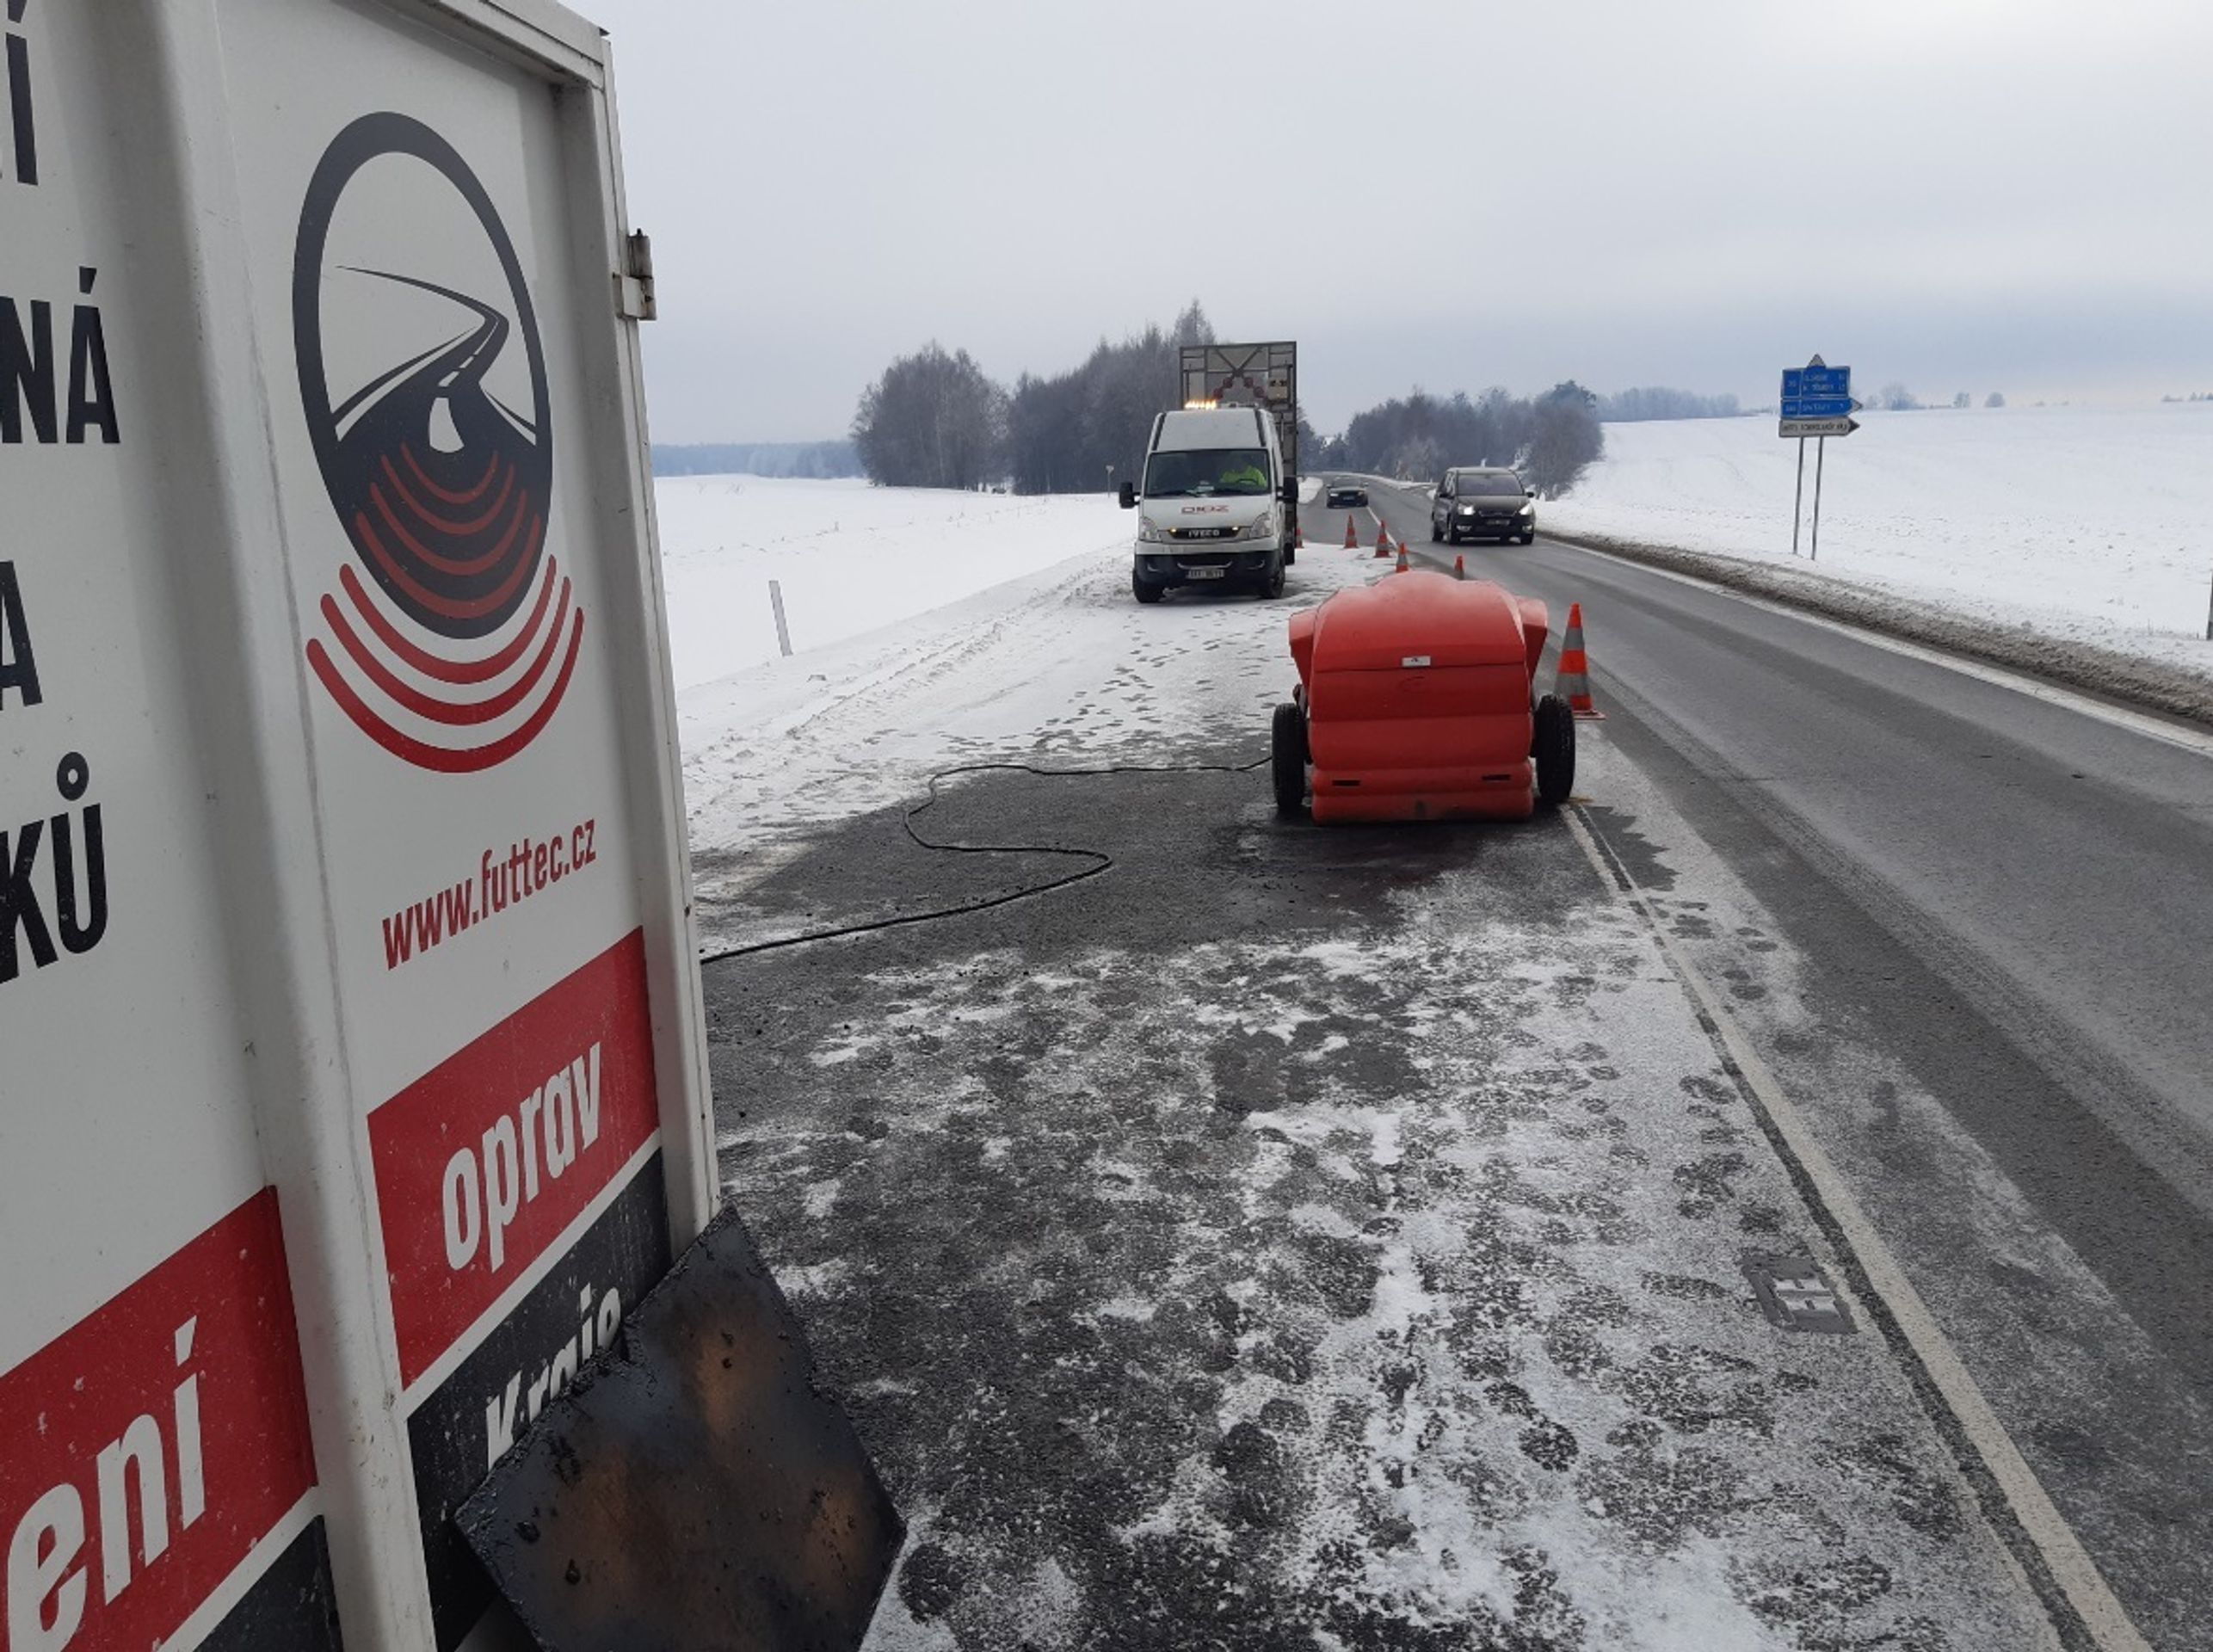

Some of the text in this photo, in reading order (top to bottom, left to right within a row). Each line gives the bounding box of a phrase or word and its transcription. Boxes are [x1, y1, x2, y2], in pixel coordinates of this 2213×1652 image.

[0, 266, 120, 443] NÁ
[0, 752, 108, 984] KŮ
[382, 818, 596, 971] www.futtec.cz
[442, 1041, 600, 1273] oprav
[8, 1316, 206, 1652] ení
